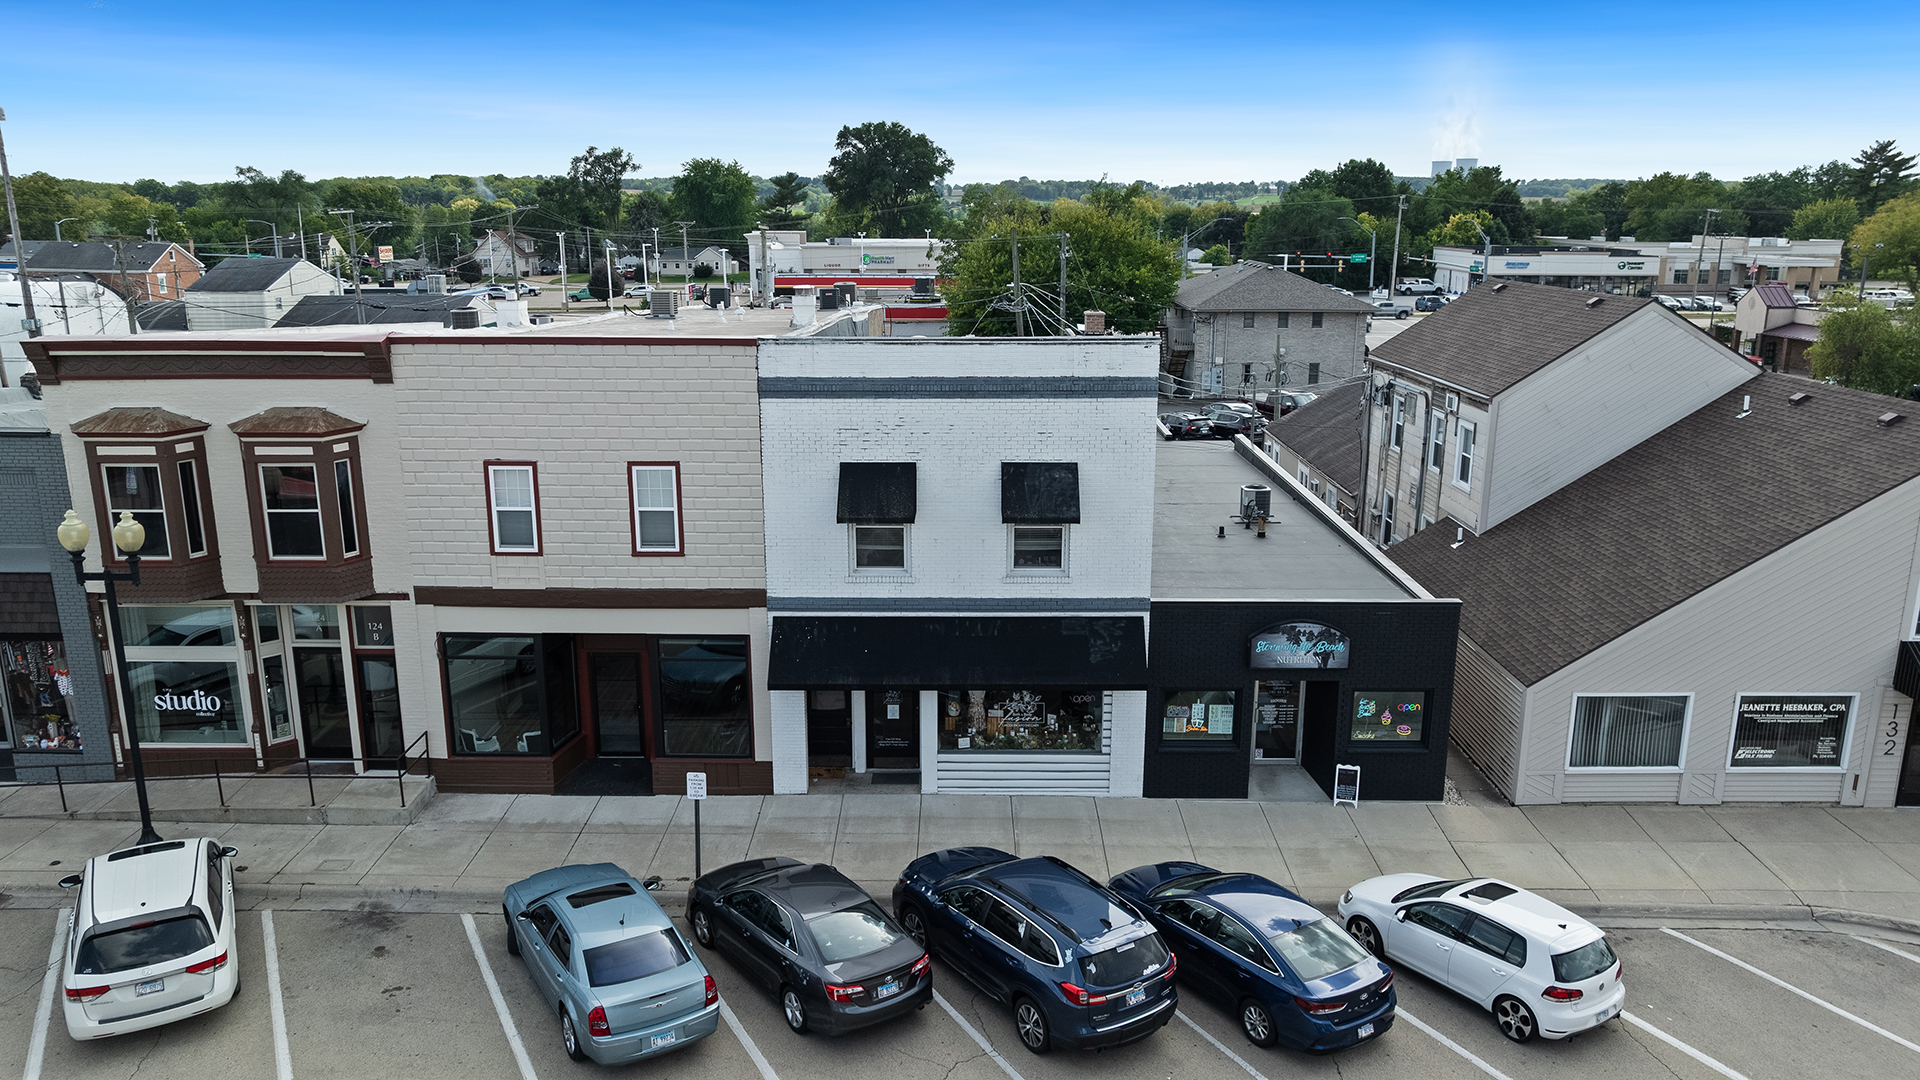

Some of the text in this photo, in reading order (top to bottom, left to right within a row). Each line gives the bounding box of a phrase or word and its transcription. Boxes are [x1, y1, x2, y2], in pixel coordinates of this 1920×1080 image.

[316, 624, 323, 632] A
[367, 622, 383, 631] 124
[373, 632, 380, 641] B
[1256, 640, 1298, 654] Storming
[1315, 640, 1346, 653] Beach
[1276, 655, 1322, 664] NUTRITION
[153, 689, 221, 711] studio
[1073, 694, 1096, 703] open
[1397, 703, 1421, 712] open
[1740, 703, 1846, 713] JEANETTE HEESAKER, CPA
[1883, 703, 1898, 756] 132
